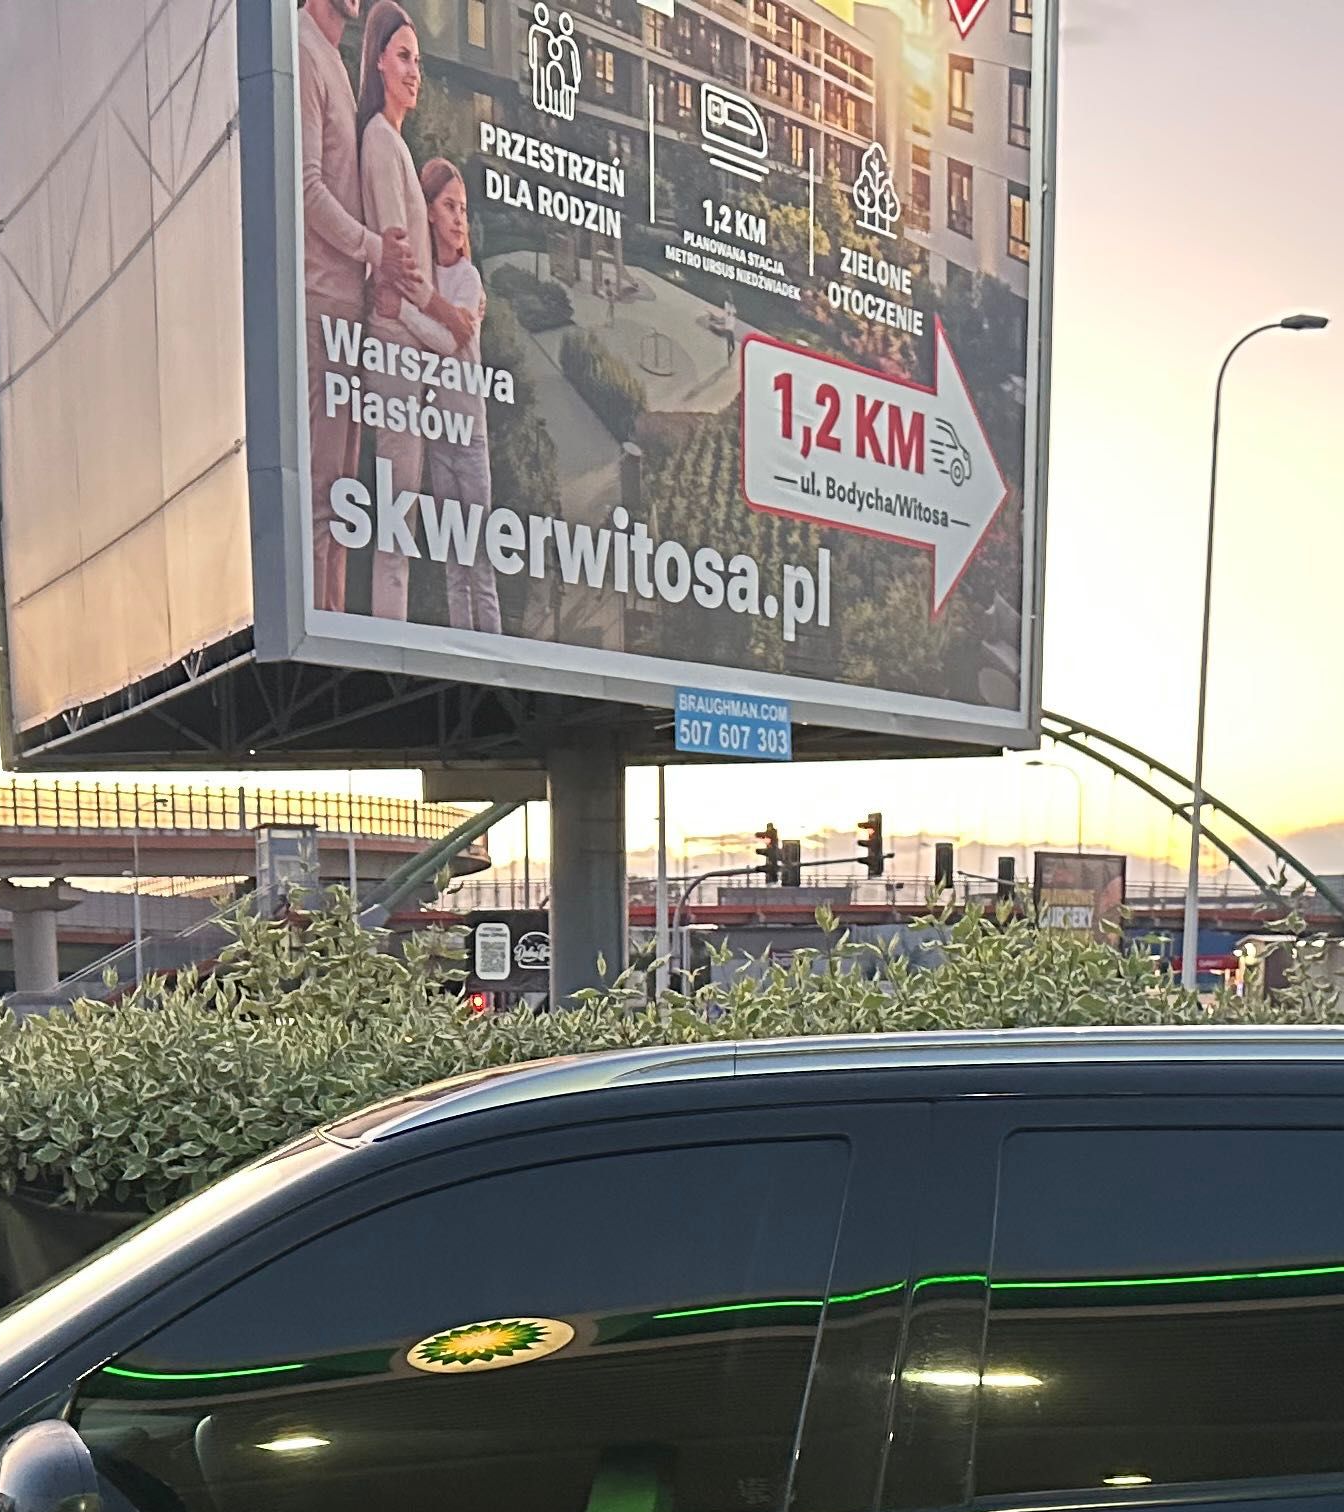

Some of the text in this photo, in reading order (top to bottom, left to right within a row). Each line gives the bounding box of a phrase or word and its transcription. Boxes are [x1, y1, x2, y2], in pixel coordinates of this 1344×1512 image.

[480, 121, 625, 198] PRZESTRZEŃ
[485, 168, 622, 239] DLA RODZIN
[702, 199, 767, 246] 1,2 KM
[664, 244, 802, 301] METRO URSUS NIEDŹWIADEK
[683, 229, 785, 277] PLANOWANA STACJA
[840, 246, 912, 296] ZIELONE
[827, 281, 924, 337] OTOCZENIE
[319, 313, 515, 405] Warszawa
[324, 371, 475, 447] Piastów
[773, 372, 926, 475] 1,2 KM
[799, 471, 949, 528] ul. Bodycha/Witosa
[328, 456, 831, 642] skwerwitosa.pl
[678, 693, 788, 722] BRAUGHMAN.COM
[679, 718, 788, 755] 507 607 303
